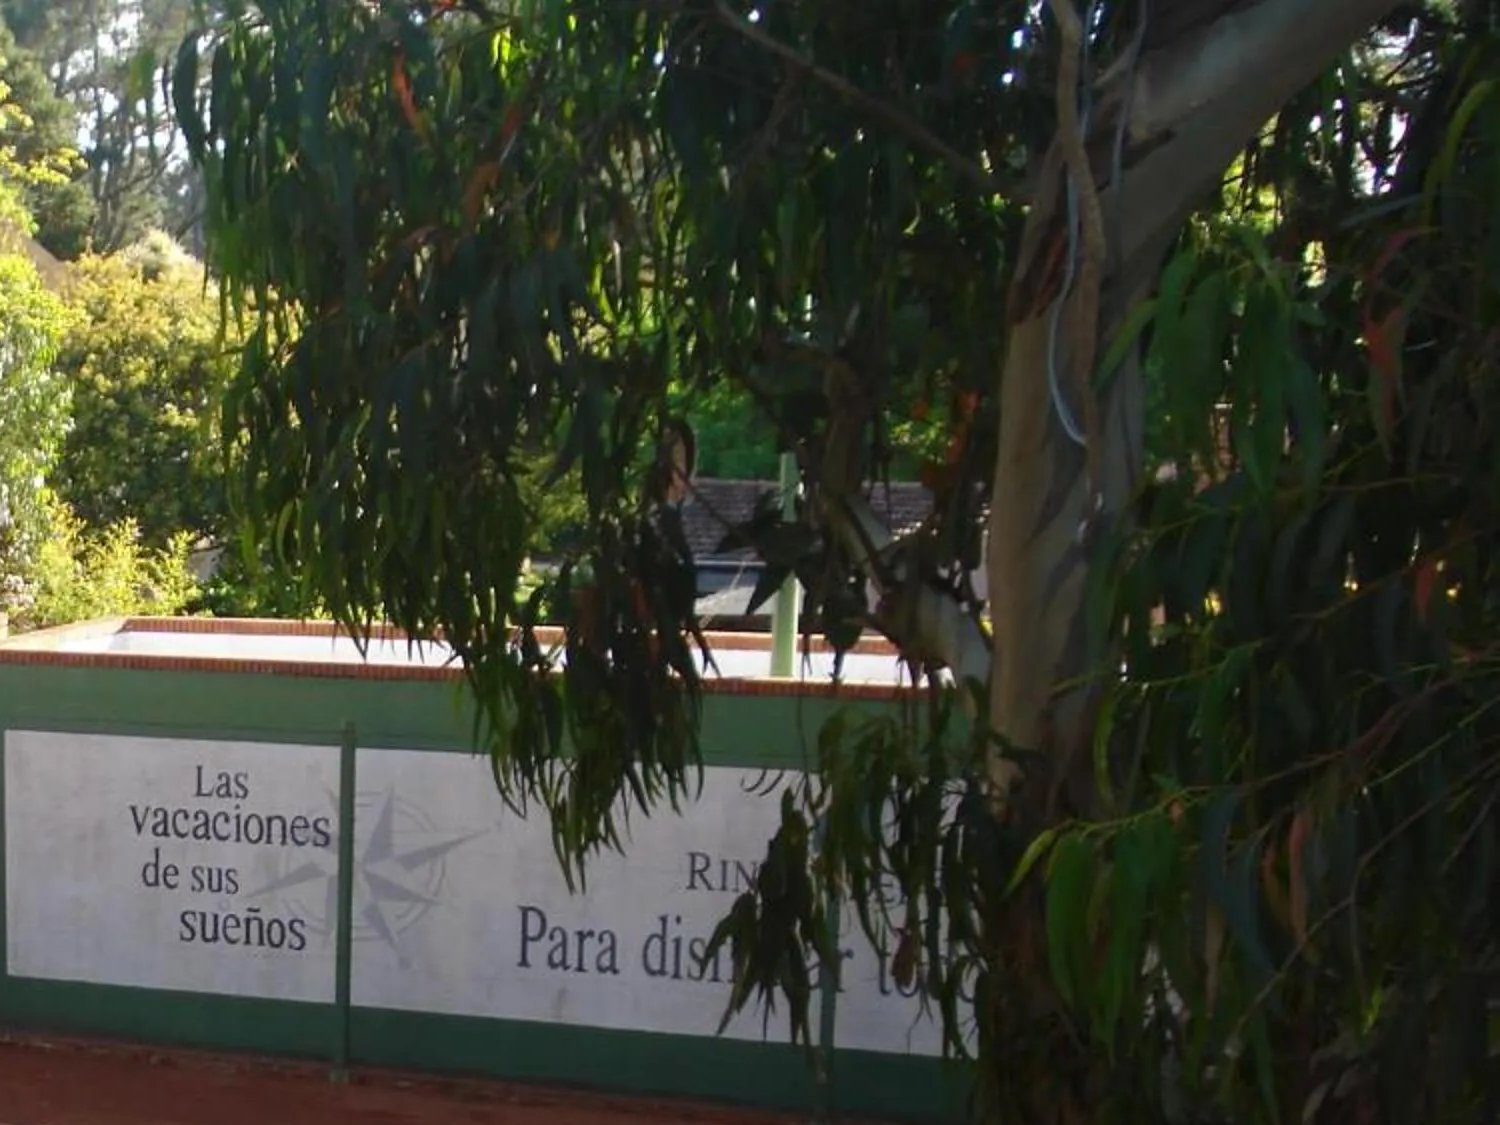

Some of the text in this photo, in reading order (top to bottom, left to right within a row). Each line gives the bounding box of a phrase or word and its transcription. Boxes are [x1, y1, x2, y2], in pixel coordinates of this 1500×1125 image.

[194, 764, 249, 800] Las
[129, 803, 332, 848] vacaciones
[141, 847, 240, 895] de sus
[685, 851, 762, 894] RIN
[178, 906, 307, 951] sueños
[515, 904, 621, 976] Para
